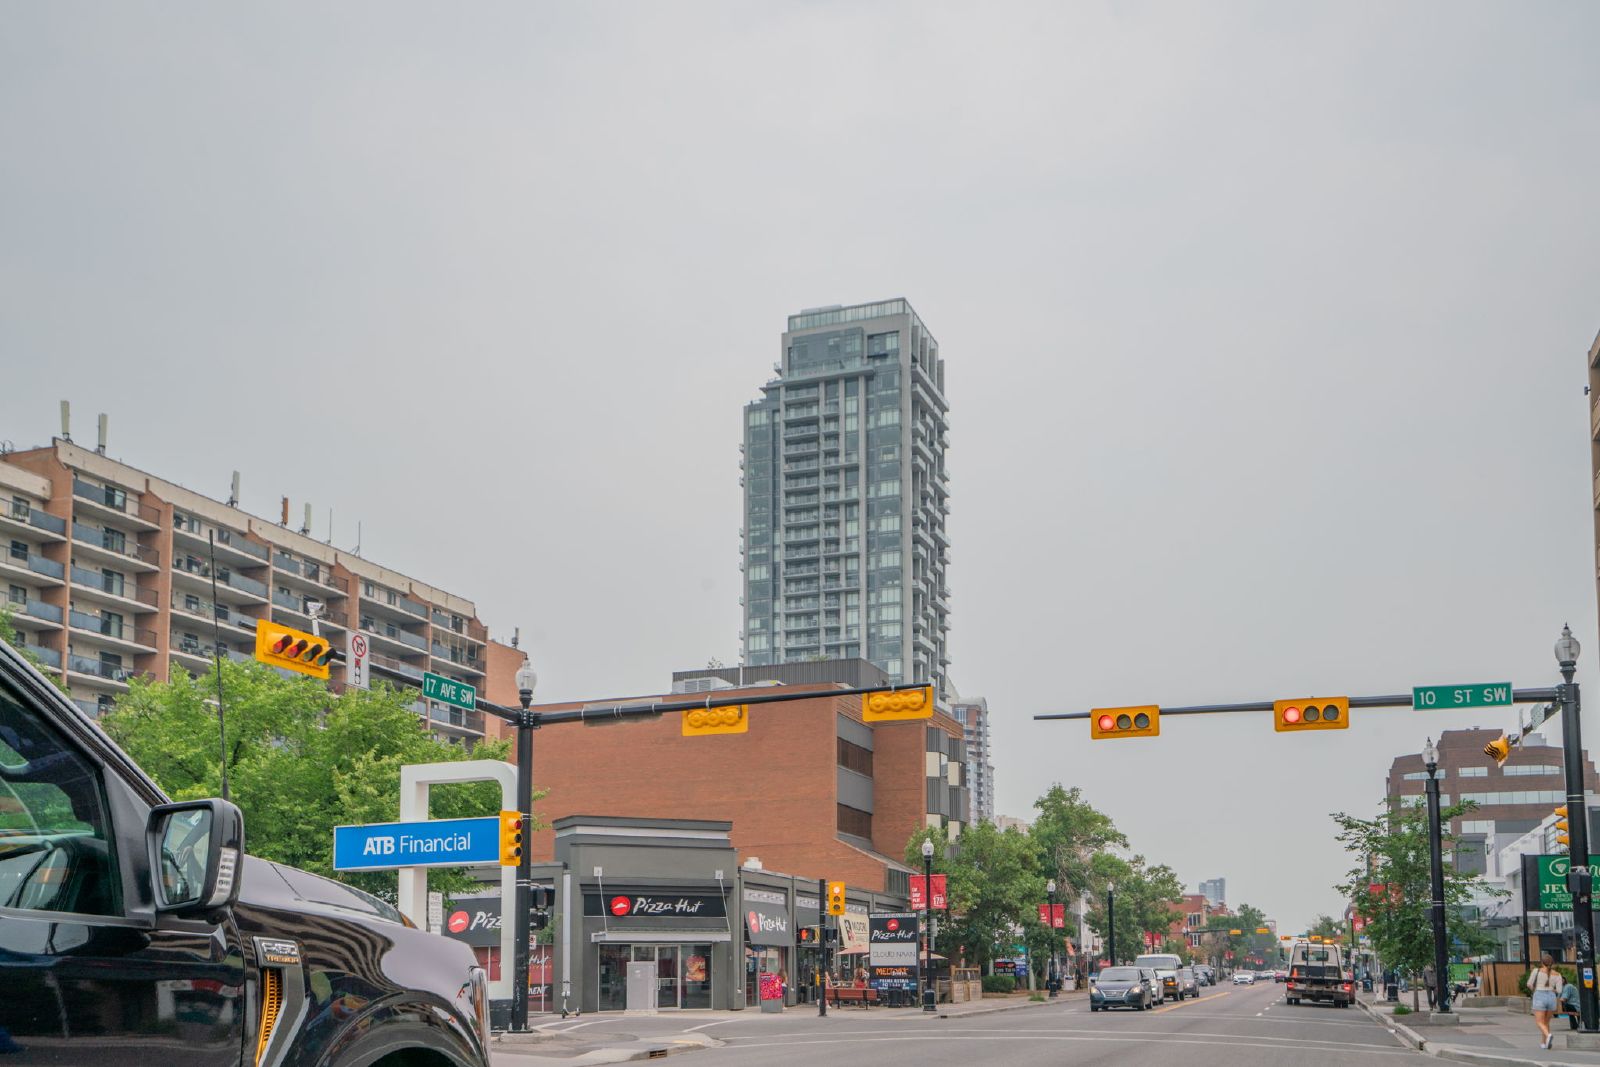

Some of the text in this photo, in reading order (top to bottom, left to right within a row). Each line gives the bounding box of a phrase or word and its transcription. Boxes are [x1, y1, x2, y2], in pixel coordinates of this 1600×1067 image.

[426, 677, 473, 705] 17 AVE SW
[1420, 687, 1506, 705] 10 ST SW
[363, 832, 471, 855] ATB Financial
[633, 897, 705, 915] Pizza Hut
[758, 913, 788, 932] Pizza Hut
[871, 929, 896, 940] Pizza
[896, 929, 916, 939] Hut
